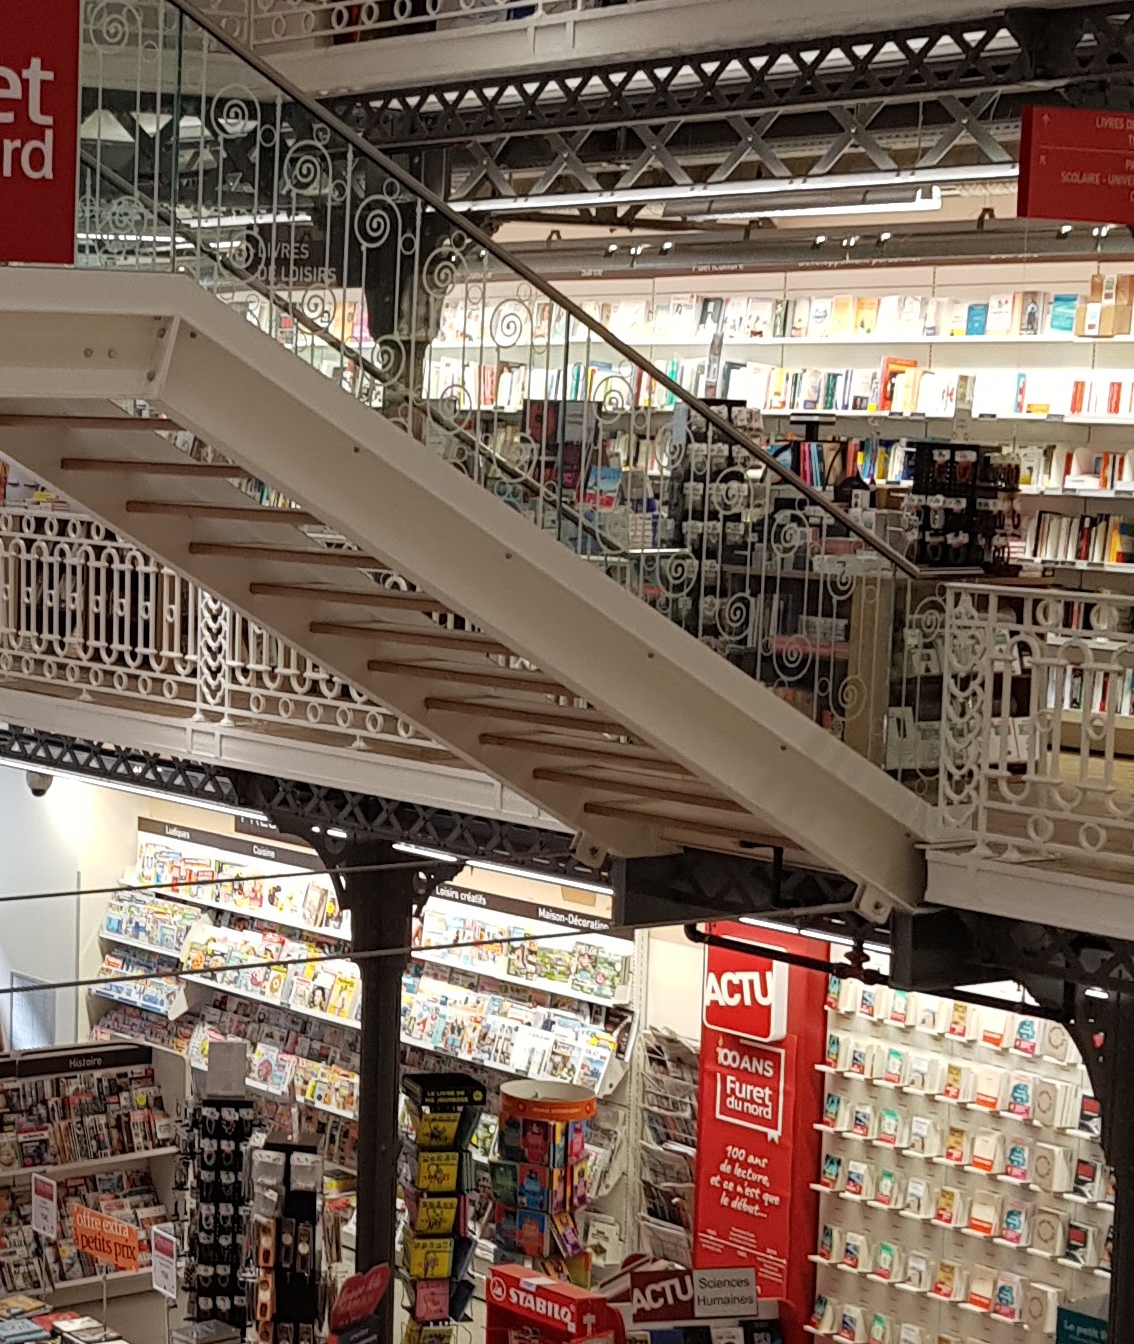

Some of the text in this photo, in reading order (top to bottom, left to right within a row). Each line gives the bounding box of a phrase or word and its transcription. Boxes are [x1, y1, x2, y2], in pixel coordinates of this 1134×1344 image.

[258, 242, 309, 259] LIVRES
[281, 265, 337, 283] LOISIRS
[705, 971, 774, 1007] ACTU
[69, 1056, 103, 1068] Histoire
[717, 1045, 774, 1078] 100 ANS
[726, 1075, 773, 1106] Furet
[726, 1095, 773, 1120] du nord
[720, 1159, 732, 1174] de
[726, 1144, 768, 1168] 100 ans
[709, 1175, 780, 1207] et ce n'est que
[720, 1190, 729, 1206] le
[76, 1210, 130, 1239] offre extra
[81, 1232, 112, 1255] petits
[113, 1239, 137, 1263] prix
[632, 1274, 694, 1312] ACTU
[698, 1277, 750, 1290] Sciences
[508, 1287, 572, 1323] STABILO
[697, 1294, 754, 1308] Humaines
